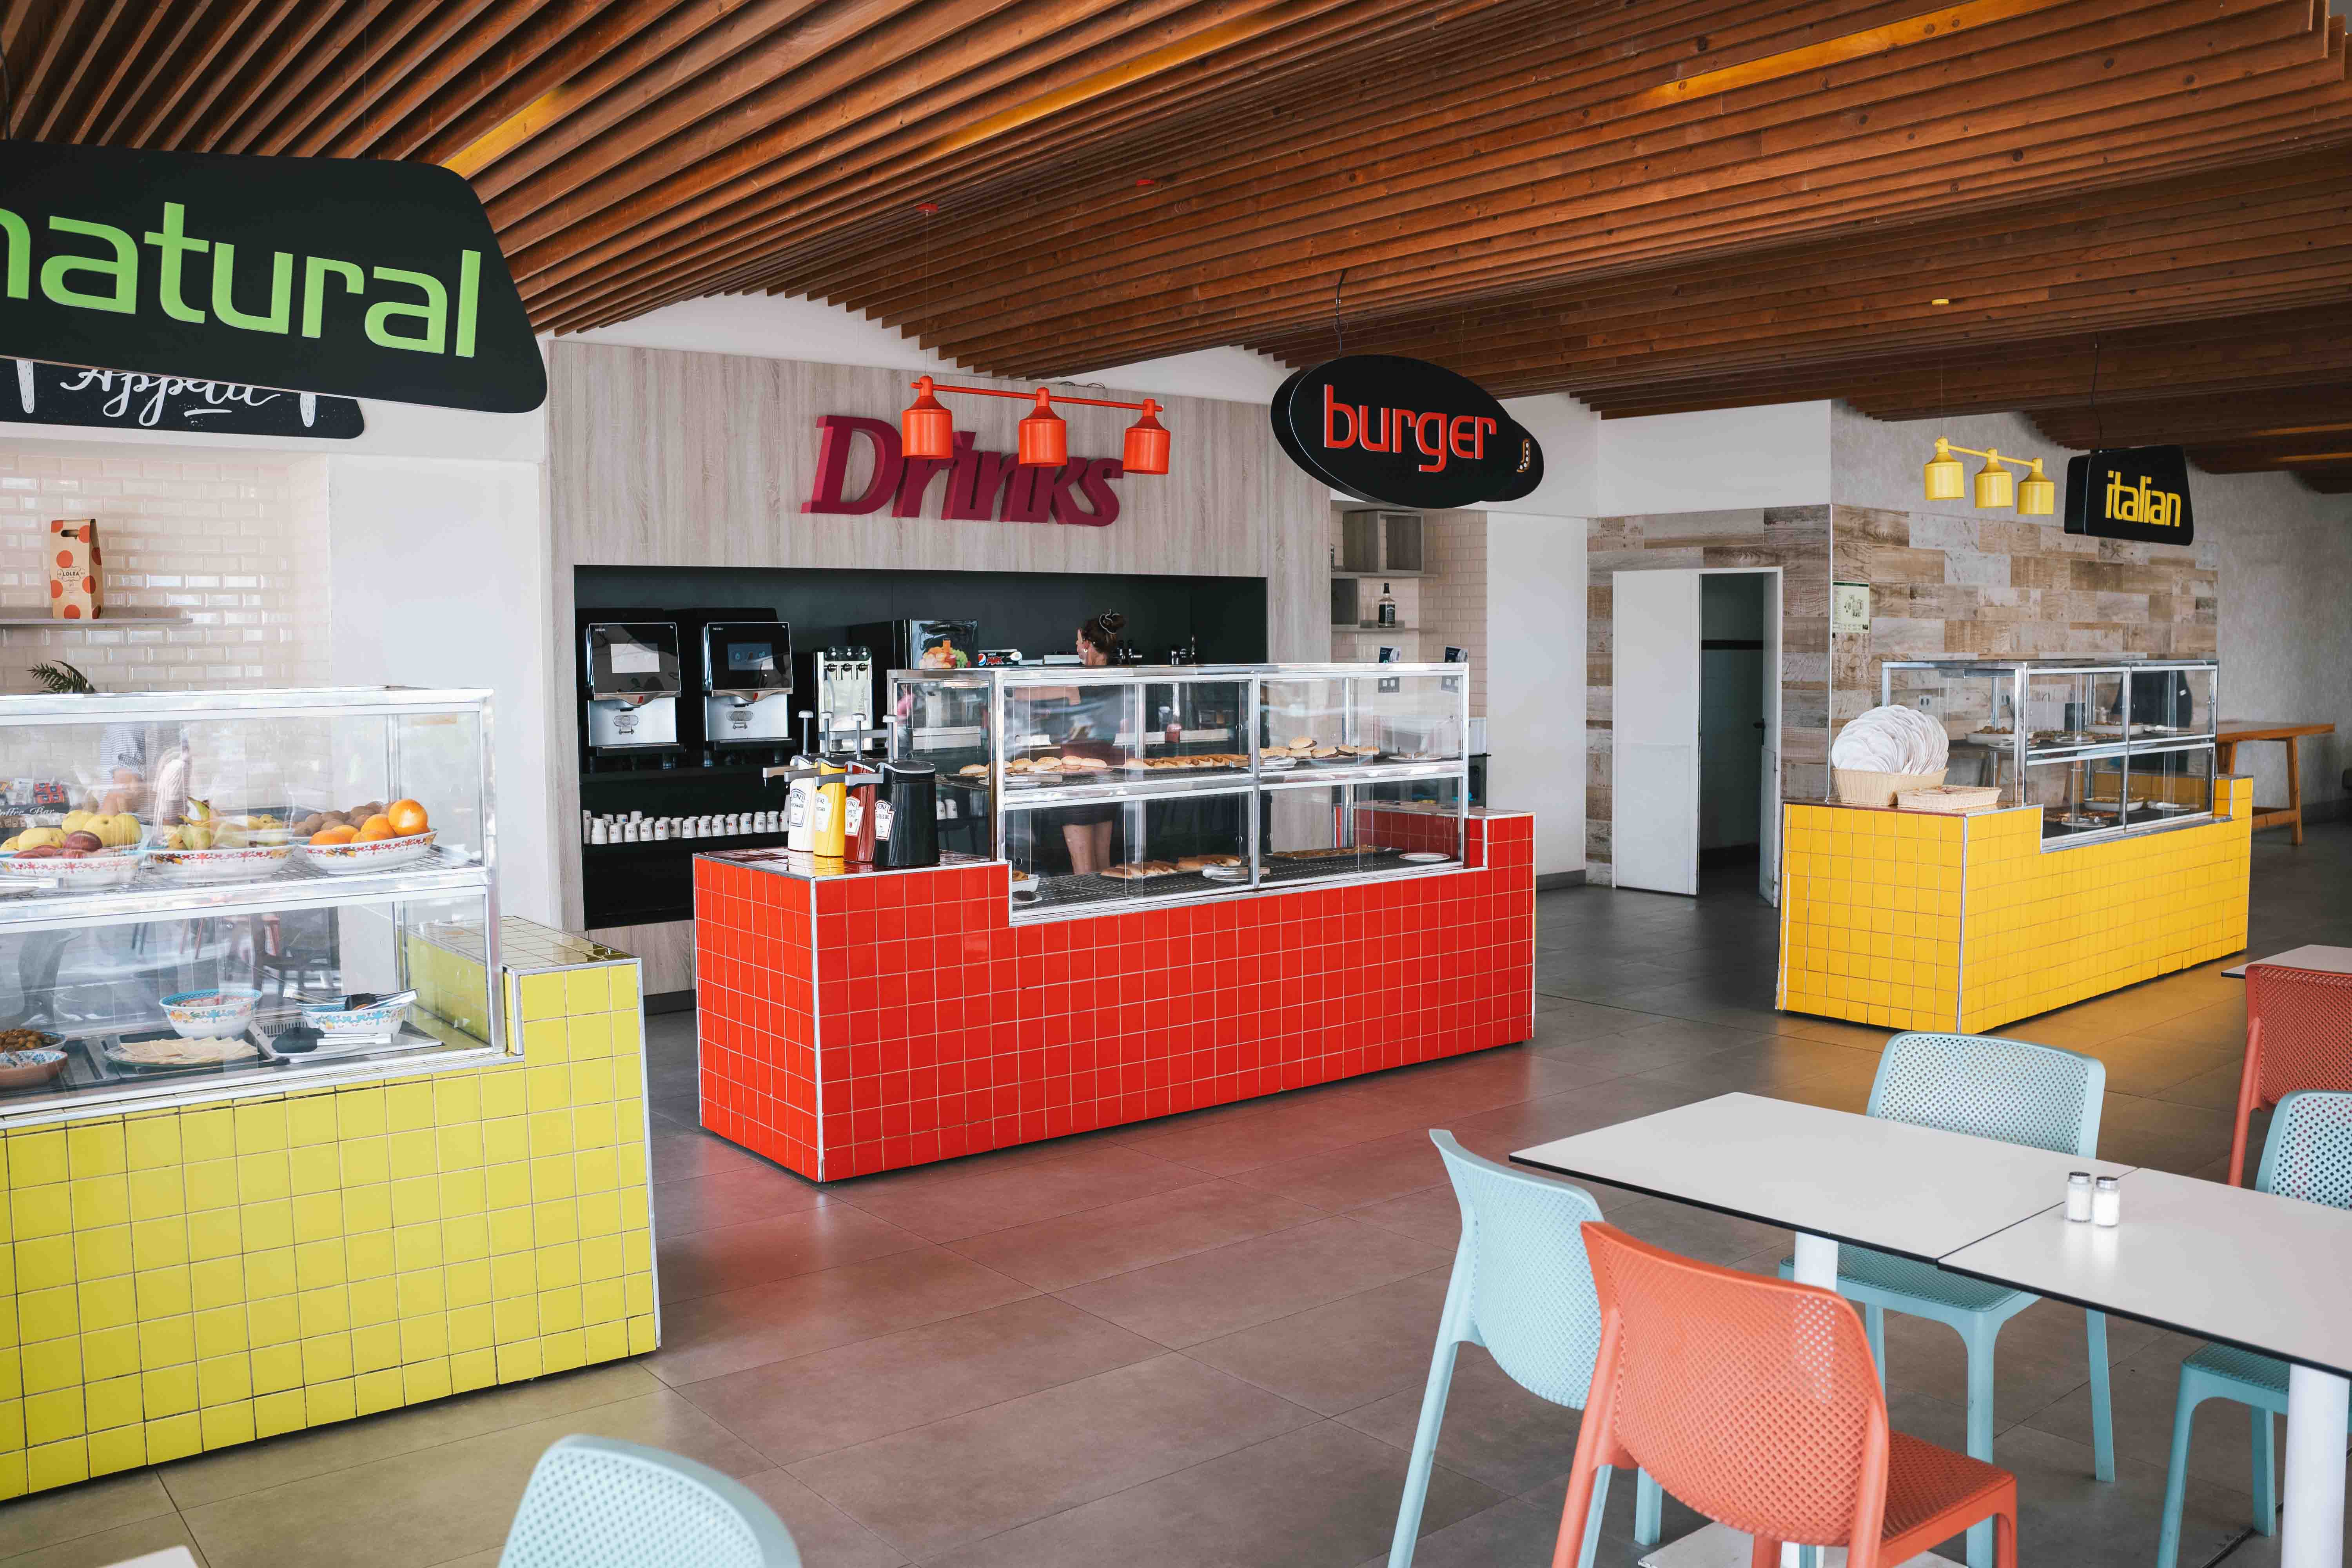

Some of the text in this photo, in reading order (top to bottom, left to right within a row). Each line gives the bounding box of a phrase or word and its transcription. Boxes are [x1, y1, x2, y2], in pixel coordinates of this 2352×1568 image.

[1323, 384, 1497, 473] burger
[801, 415, 1124, 527] Drinks
[2105, 470, 2181, 527] italian
[0, 806, 55, 816] offee Bar
